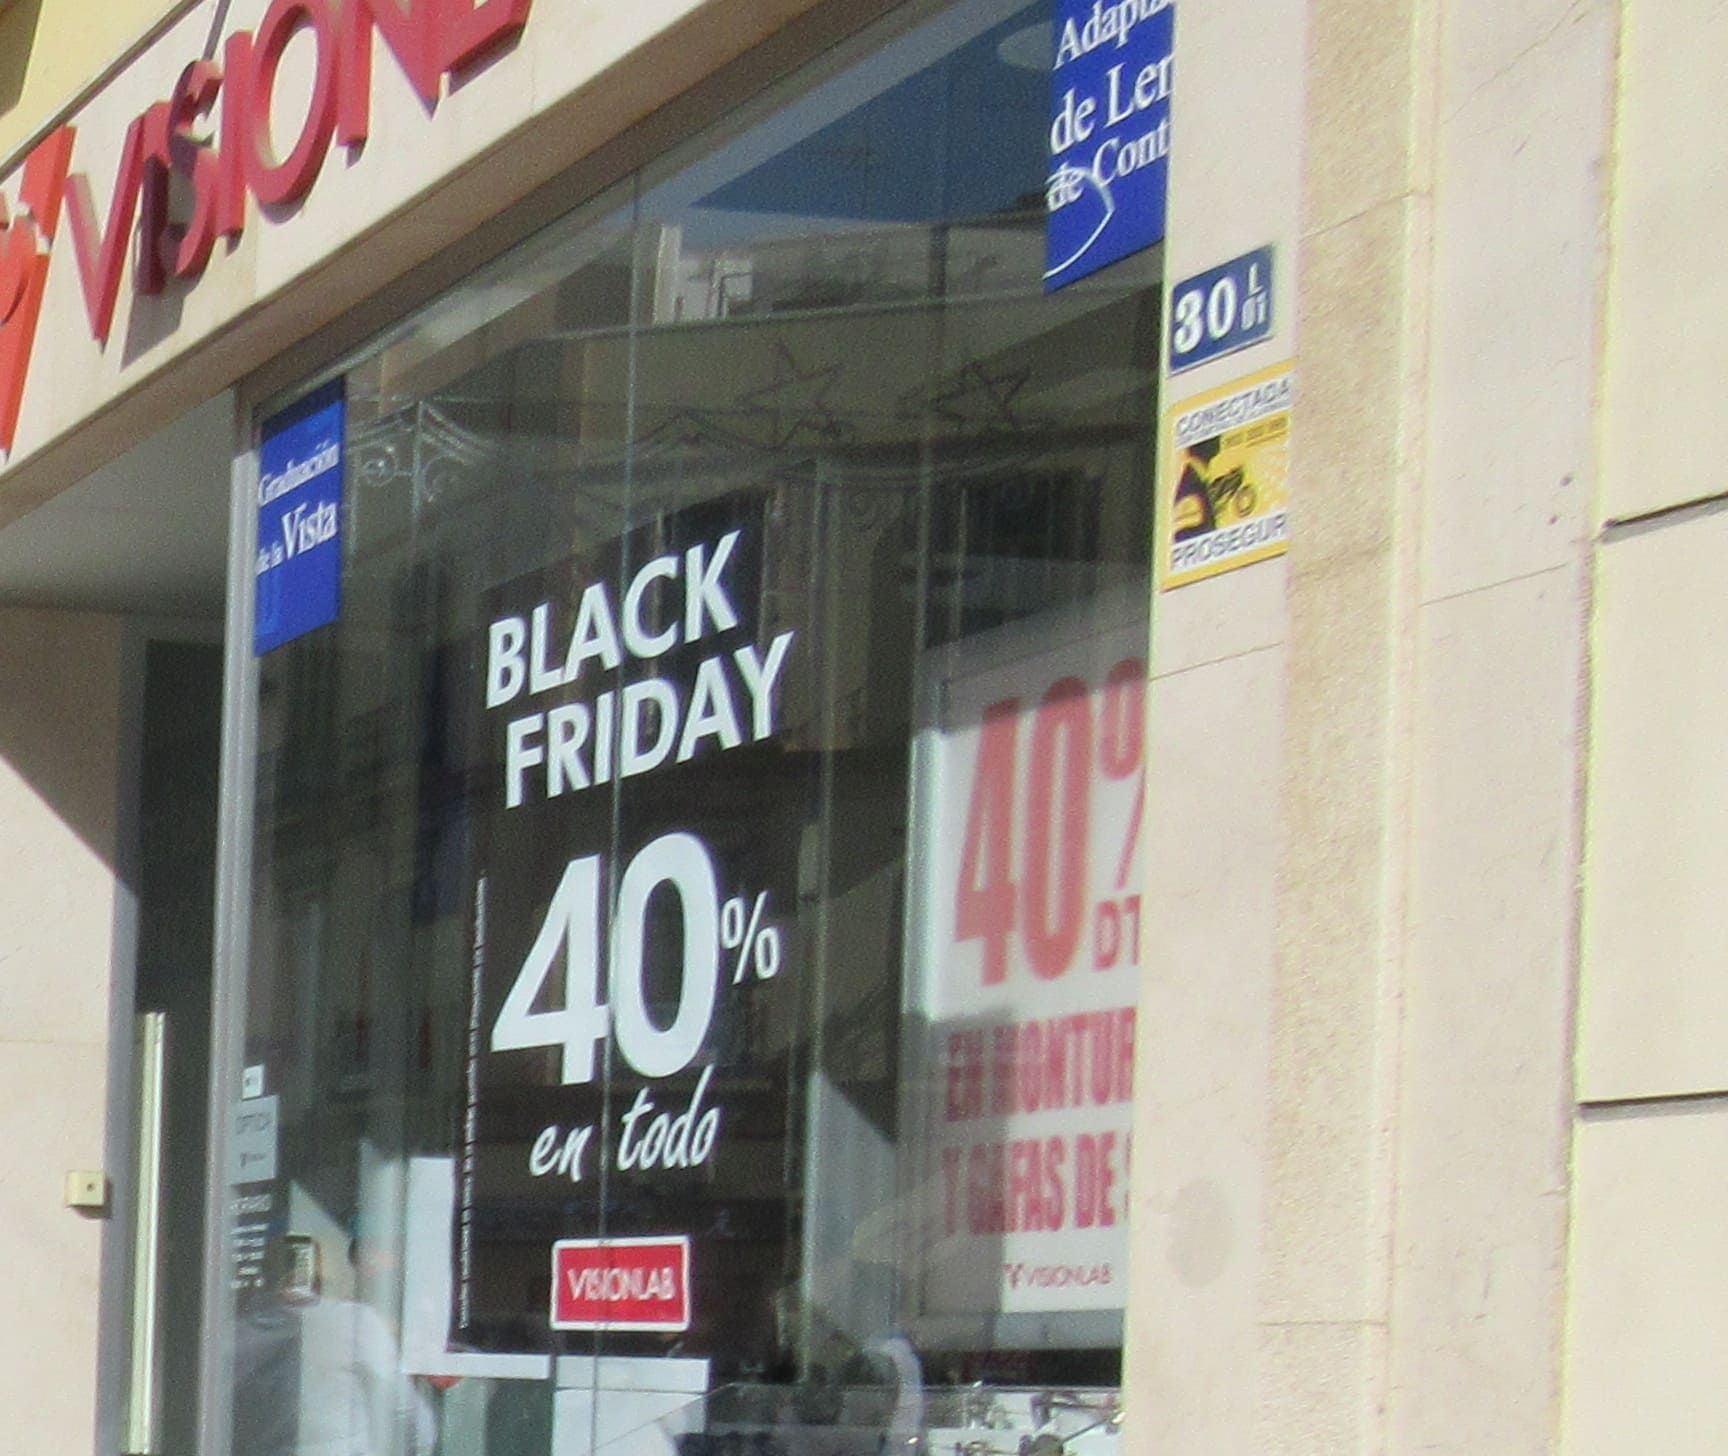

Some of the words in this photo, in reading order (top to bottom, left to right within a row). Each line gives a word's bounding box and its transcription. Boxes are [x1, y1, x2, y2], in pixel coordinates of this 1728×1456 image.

[1050, 83, 1096, 156] de
[1172, 276, 1238, 355] 30
[281, 500, 338, 561] Vista
[1172, 511, 1287, 569] PROSEGUR
[485, 528, 742, 711] BLACK
[505, 630, 796, 811] FRIDAY
[528, 1124, 594, 1184] en
[616, 1064, 722, 1172] todo
[1074, 1129, 1118, 1230] DE
[568, 1265, 676, 1303] VISIONLAB
